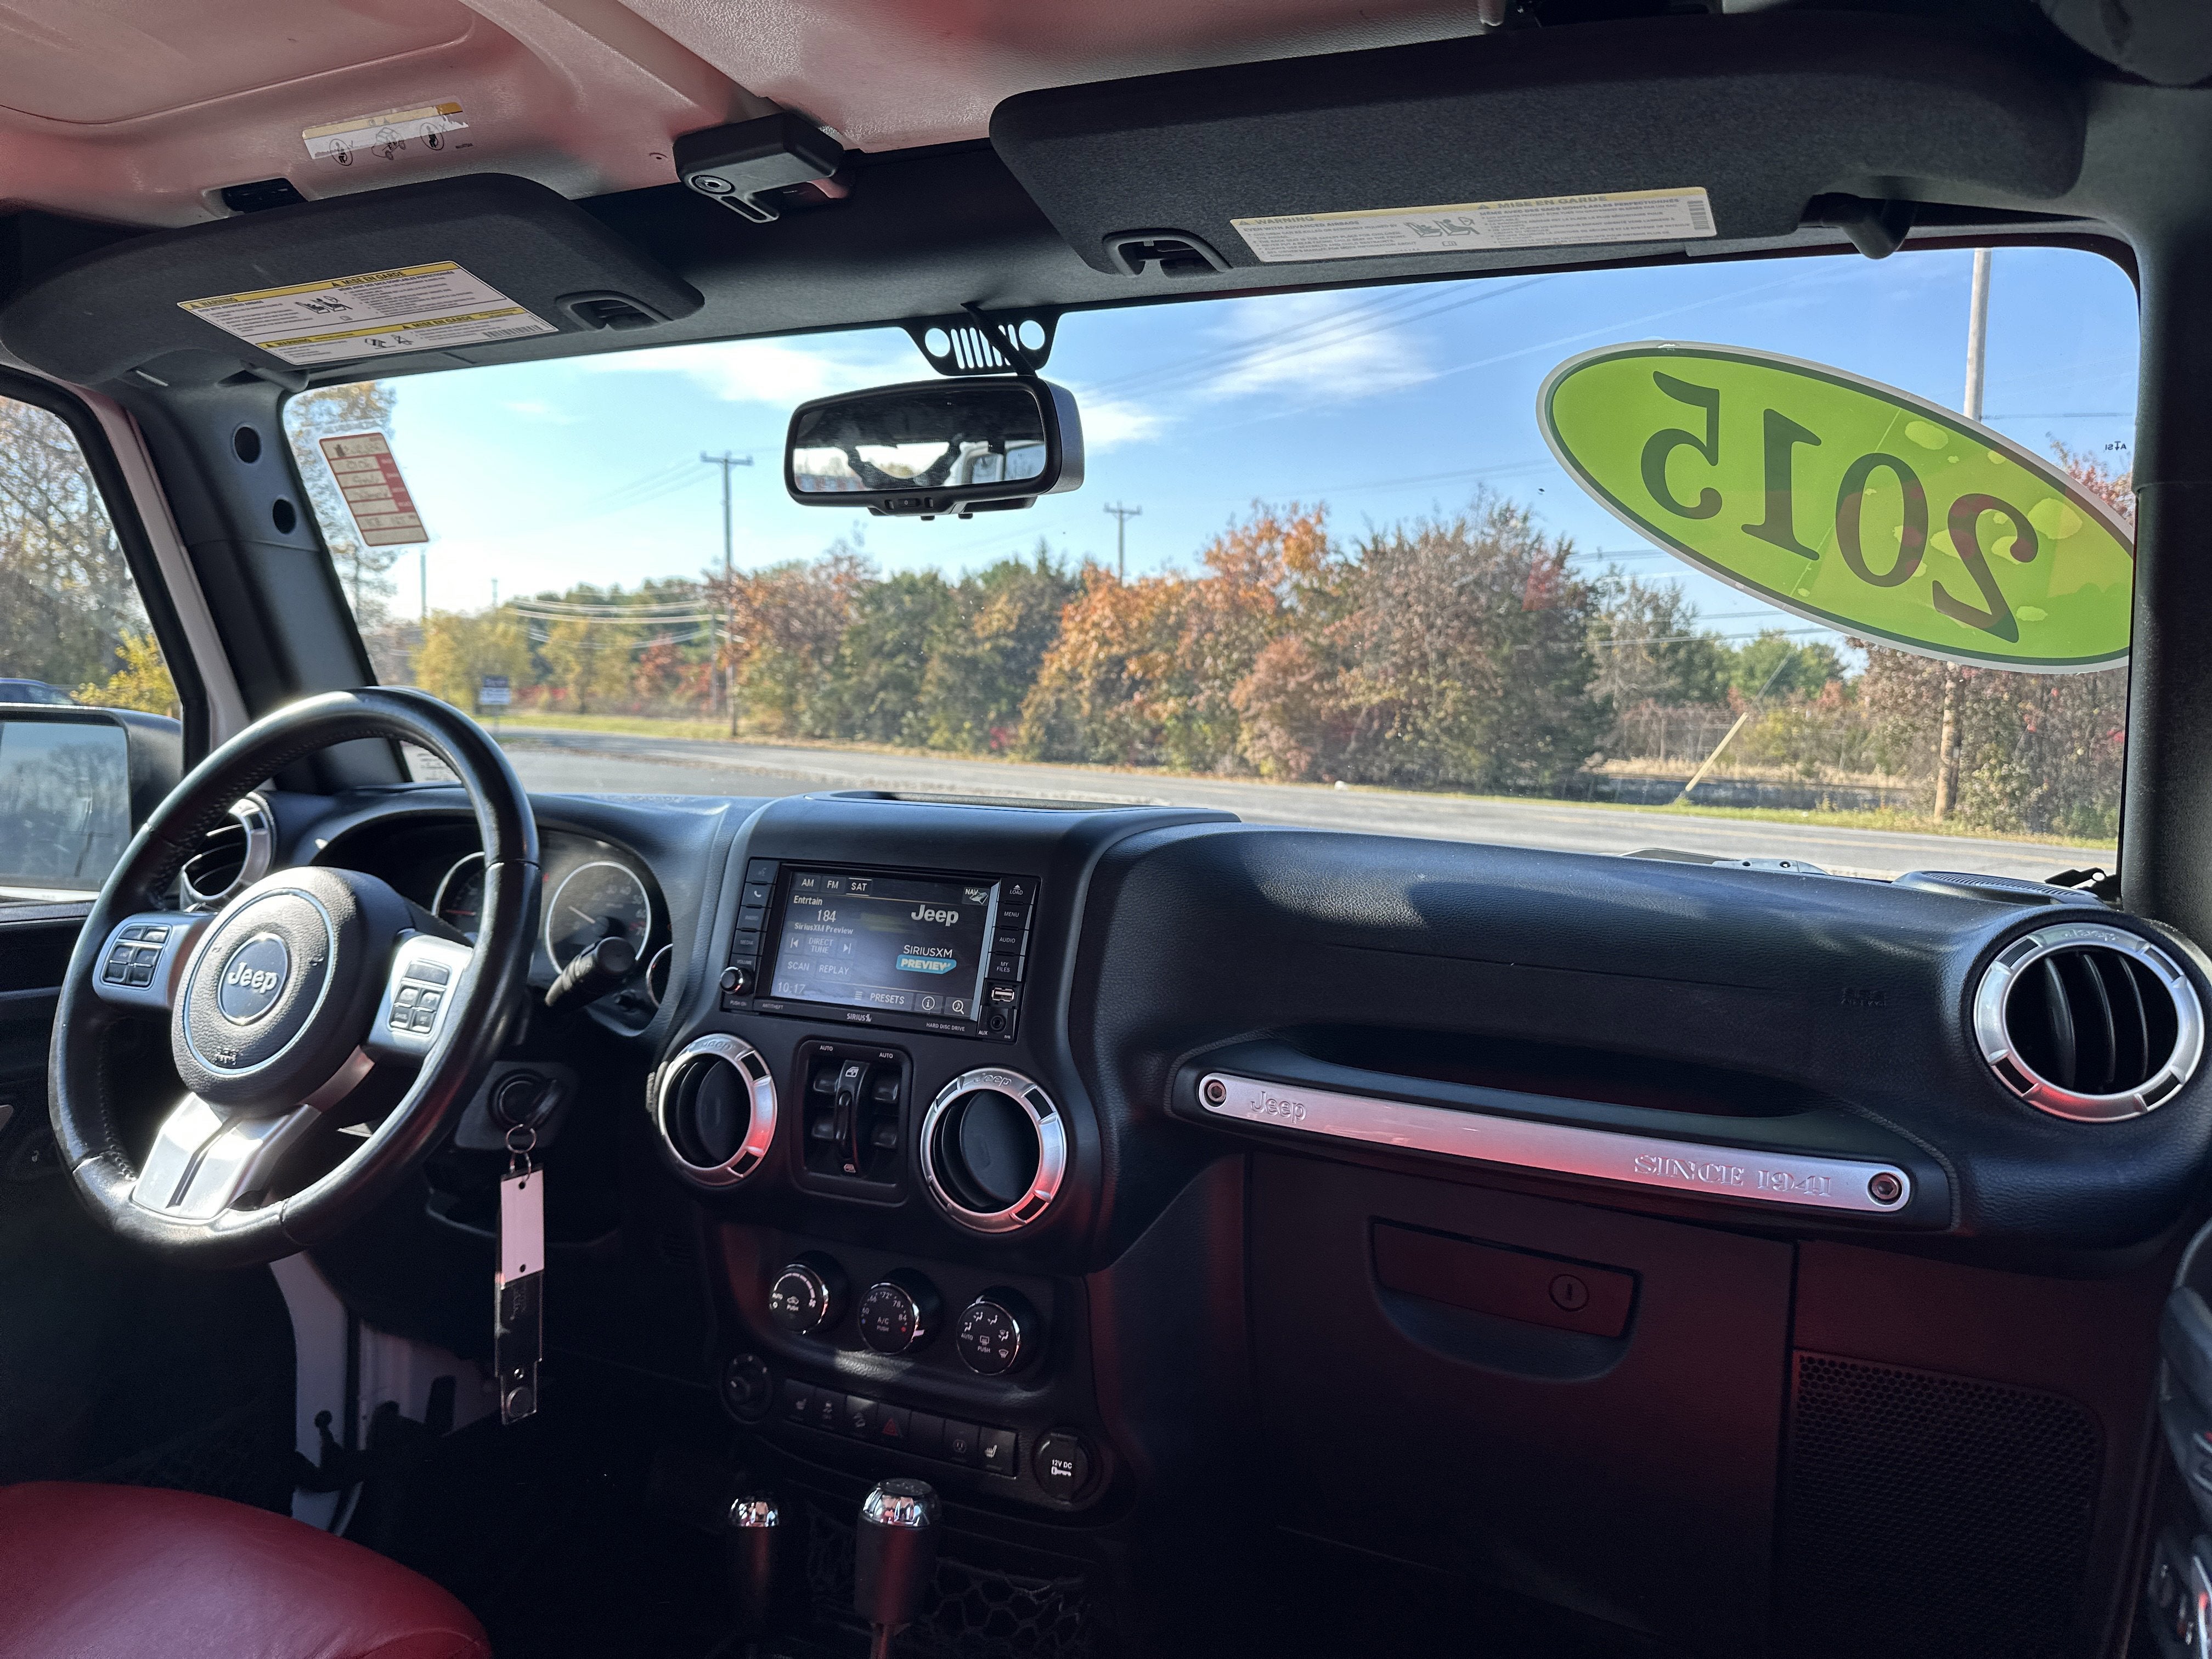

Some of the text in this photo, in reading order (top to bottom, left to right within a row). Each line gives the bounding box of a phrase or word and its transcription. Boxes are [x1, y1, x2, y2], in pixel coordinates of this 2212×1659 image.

[1256, 216, 1314, 225] WARNING
[341, 277, 363, 286] MISE
[376, 271, 407, 280] GARDE
[200, 297, 238, 307] WARNING
[412, 320, 433, 328] MISE
[447, 315, 473, 324] GARDE
[801, 878, 867, 891] AM FM SAT
[793, 895, 823, 905] Entrtain
[817, 909, 837, 922] 184
[911, 904, 959, 927] Jeep
[794, 922, 854, 935] SiriusXM Preview
[809, 937, 834, 946] DIRECT
[903, 944, 953, 958] SIRIUSXM
[787, 961, 810, 971] SCAN
[819, 964, 849, 975] REPLAY
[900, 958, 951, 971] PREVIEW
[228, 962, 277, 994] Jeep
[778, 981, 806, 994] 10:17
[870, 992, 905, 1005] PRESETS
[973, 1073, 1012, 1087] Jeep
[1250, 1091, 1306, 1125] Jeep
[1634, 1154, 1831, 1197] SINCE 1941
[882, 1291, 890, 1300] 72
[877, 1317, 889, 1325] A/C
[961, 1333, 974, 1341] AUTO
[1052, 1459, 1073, 1470] 12V DC
